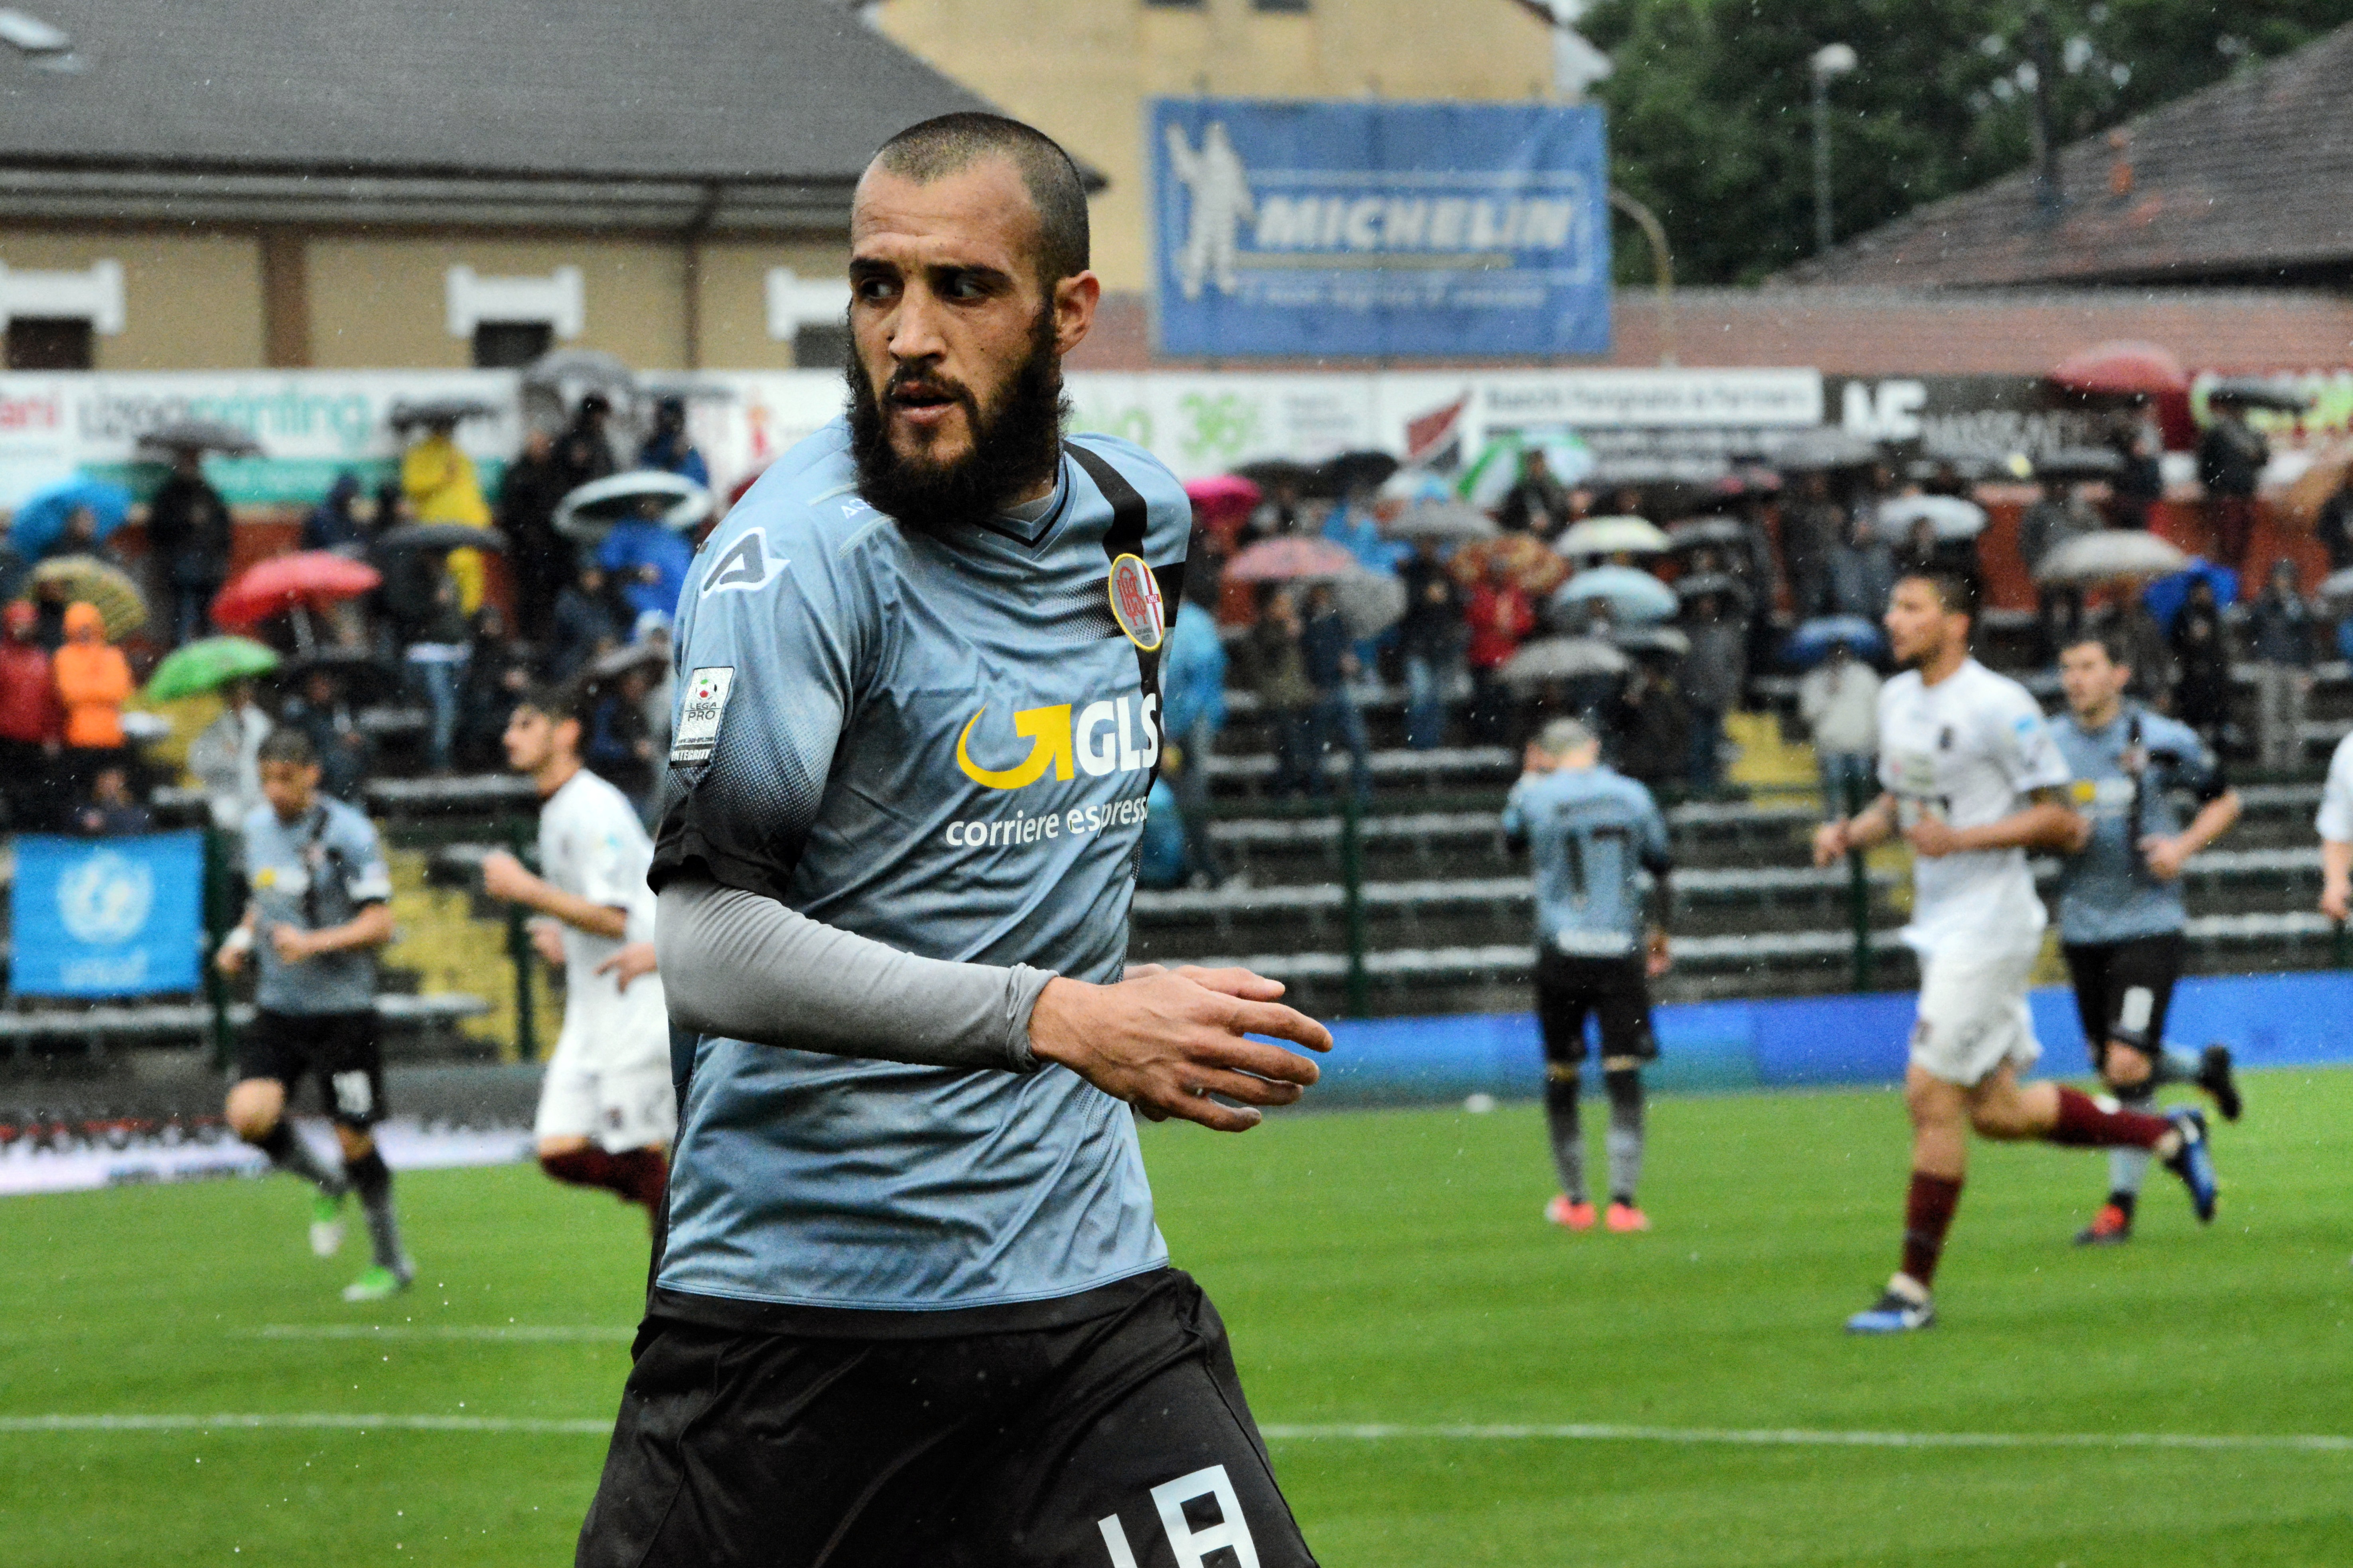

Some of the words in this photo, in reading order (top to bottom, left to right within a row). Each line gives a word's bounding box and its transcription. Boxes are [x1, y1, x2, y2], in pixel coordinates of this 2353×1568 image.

[1256, 194, 1572, 248] MICHELIN
[1147, 594, 1158, 603] 1912
[688, 710, 716, 721] PRO
[1076, 693, 1158, 776] GLS
[946, 810, 1059, 847] corriere
